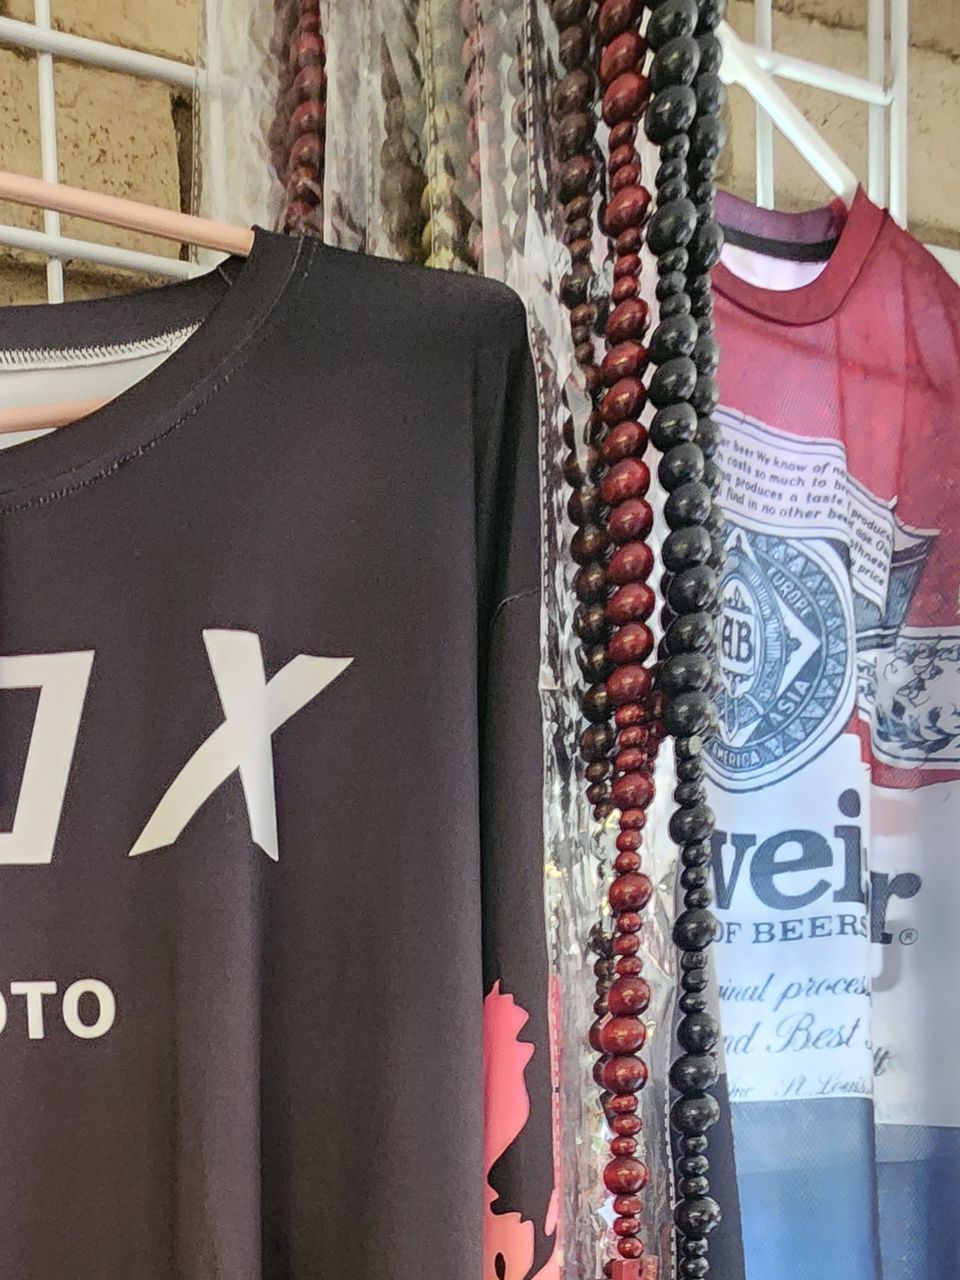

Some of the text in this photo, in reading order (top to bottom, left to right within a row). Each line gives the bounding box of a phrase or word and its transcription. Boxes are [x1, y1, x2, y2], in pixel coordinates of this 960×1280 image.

[773, 456, 807, 472] know
[812, 461, 830, 475] of
[769, 474, 805, 487] much
[812, 477, 827, 488] to
[779, 507, 822, 519] other
[769, 680, 810, 725] ASIA
[766, 1012, 861, 1055] Best
